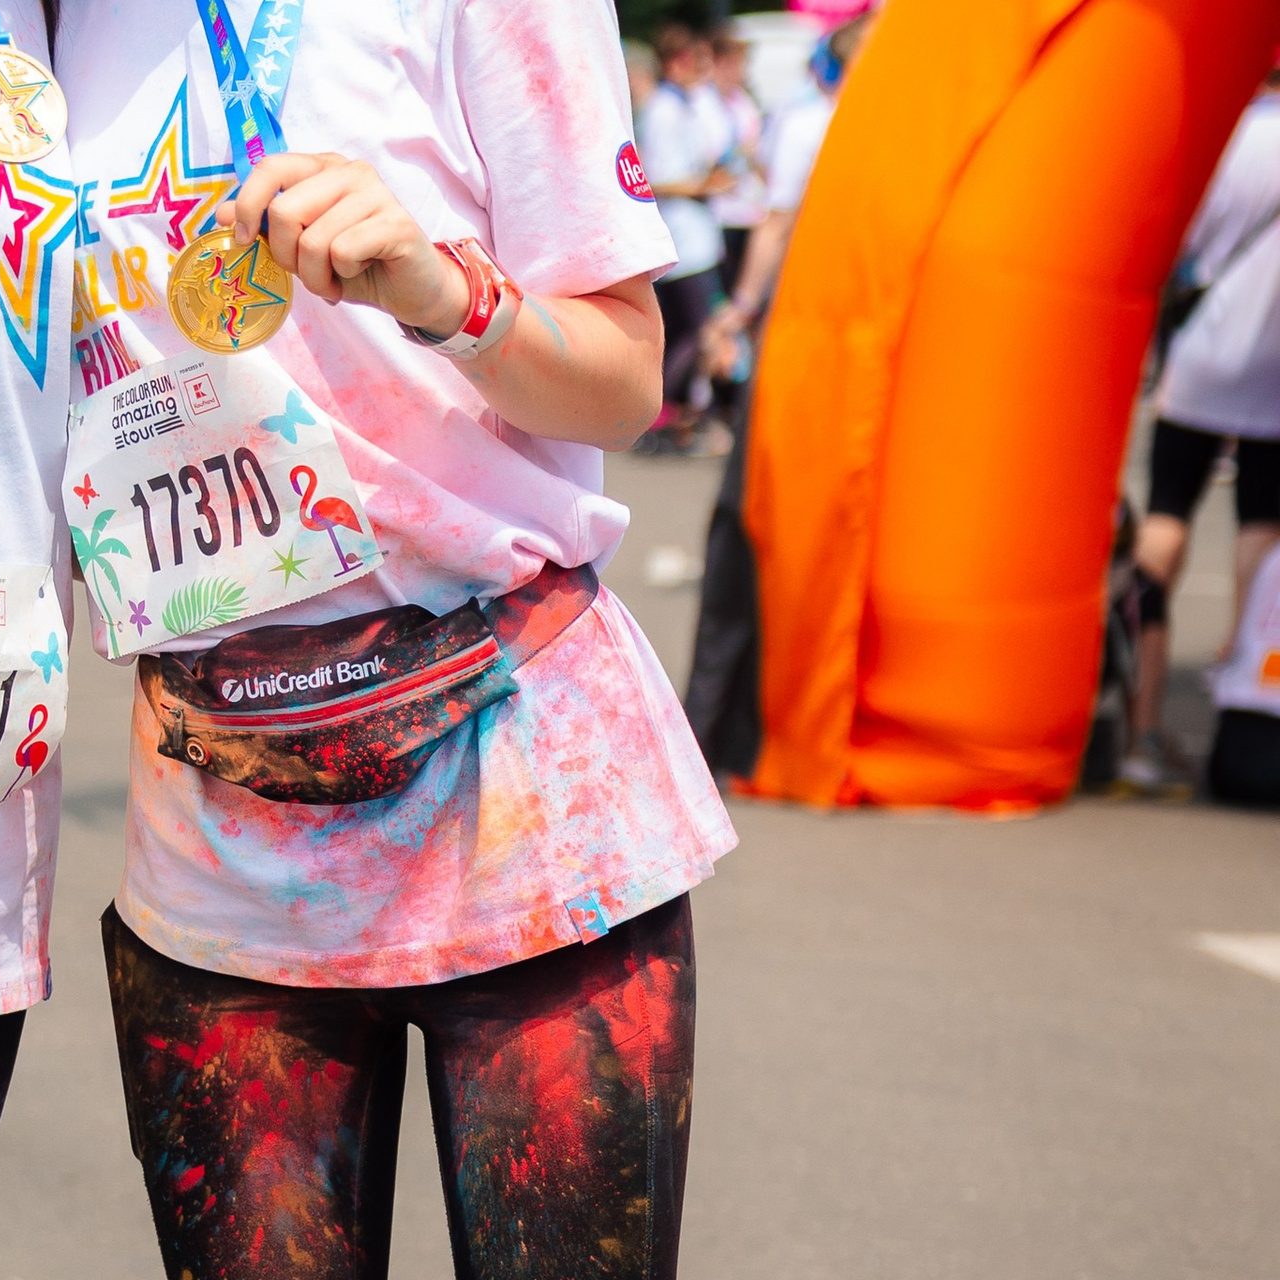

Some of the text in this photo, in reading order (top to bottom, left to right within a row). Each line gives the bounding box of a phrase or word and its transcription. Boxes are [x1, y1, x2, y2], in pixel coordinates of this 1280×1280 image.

[125, 382, 150, 406] COLOR
[112, 396, 177, 430] amazing
[122, 424, 155, 446] tour
[130, 446, 281, 572] 17370
[244, 655, 388, 699] UniCredit Bank
